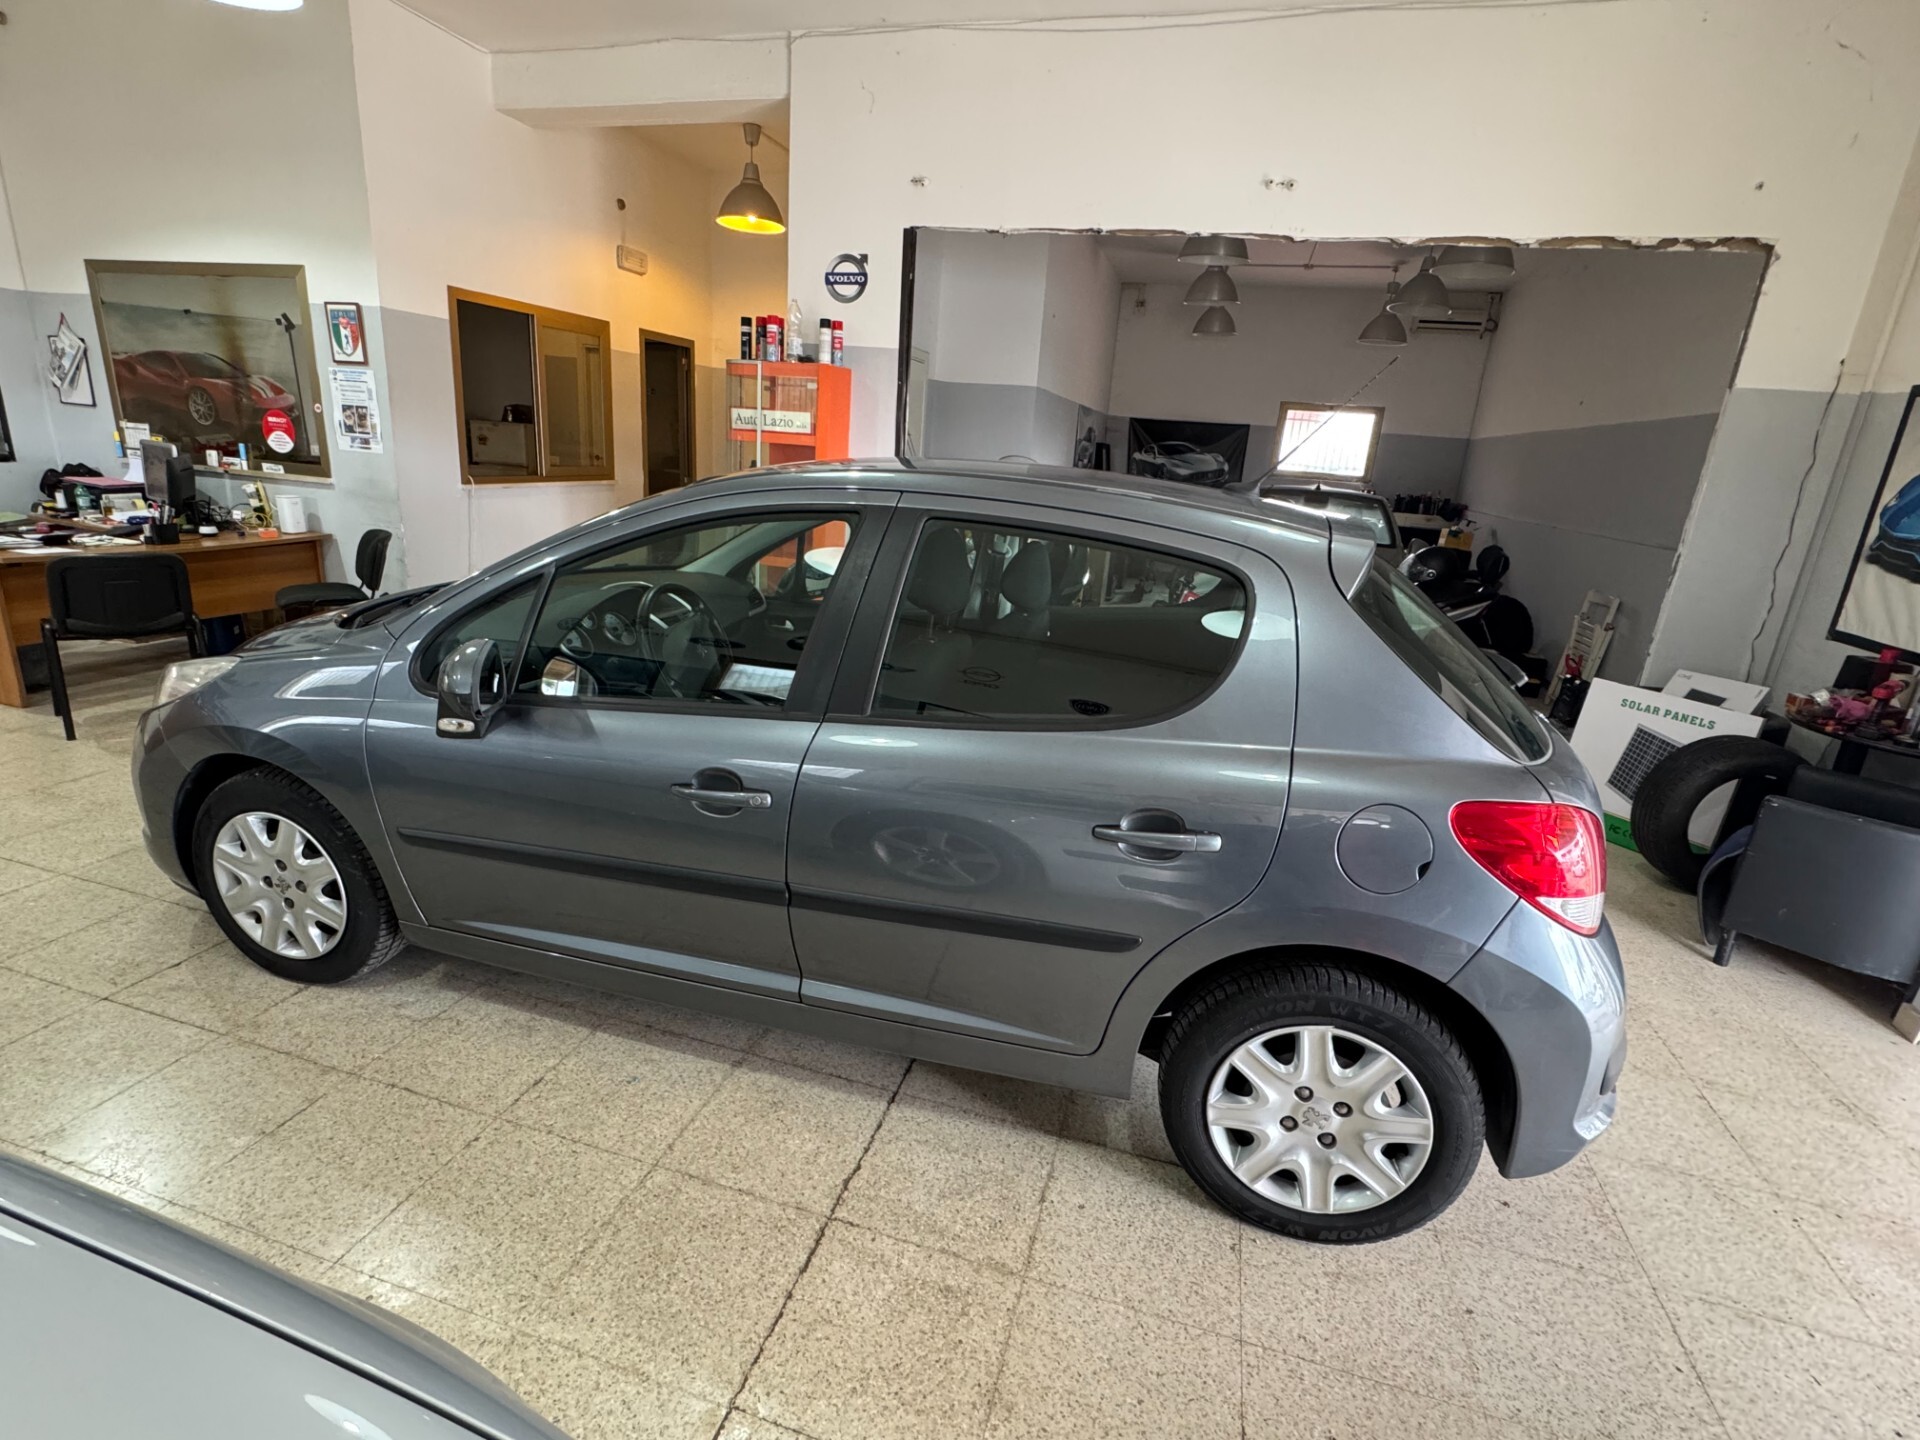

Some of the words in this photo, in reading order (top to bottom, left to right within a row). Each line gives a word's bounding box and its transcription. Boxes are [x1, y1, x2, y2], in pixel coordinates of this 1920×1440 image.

[827, 275, 865, 283] VOLVO
[763, 414, 794, 428] Lazio
[1620, 698, 1661, 716] SOLAR
[1663, 709, 1717, 730] PANELS
[1246, 999, 1316, 1022] AVON
[1318, 1223, 1392, 1241] AVON
